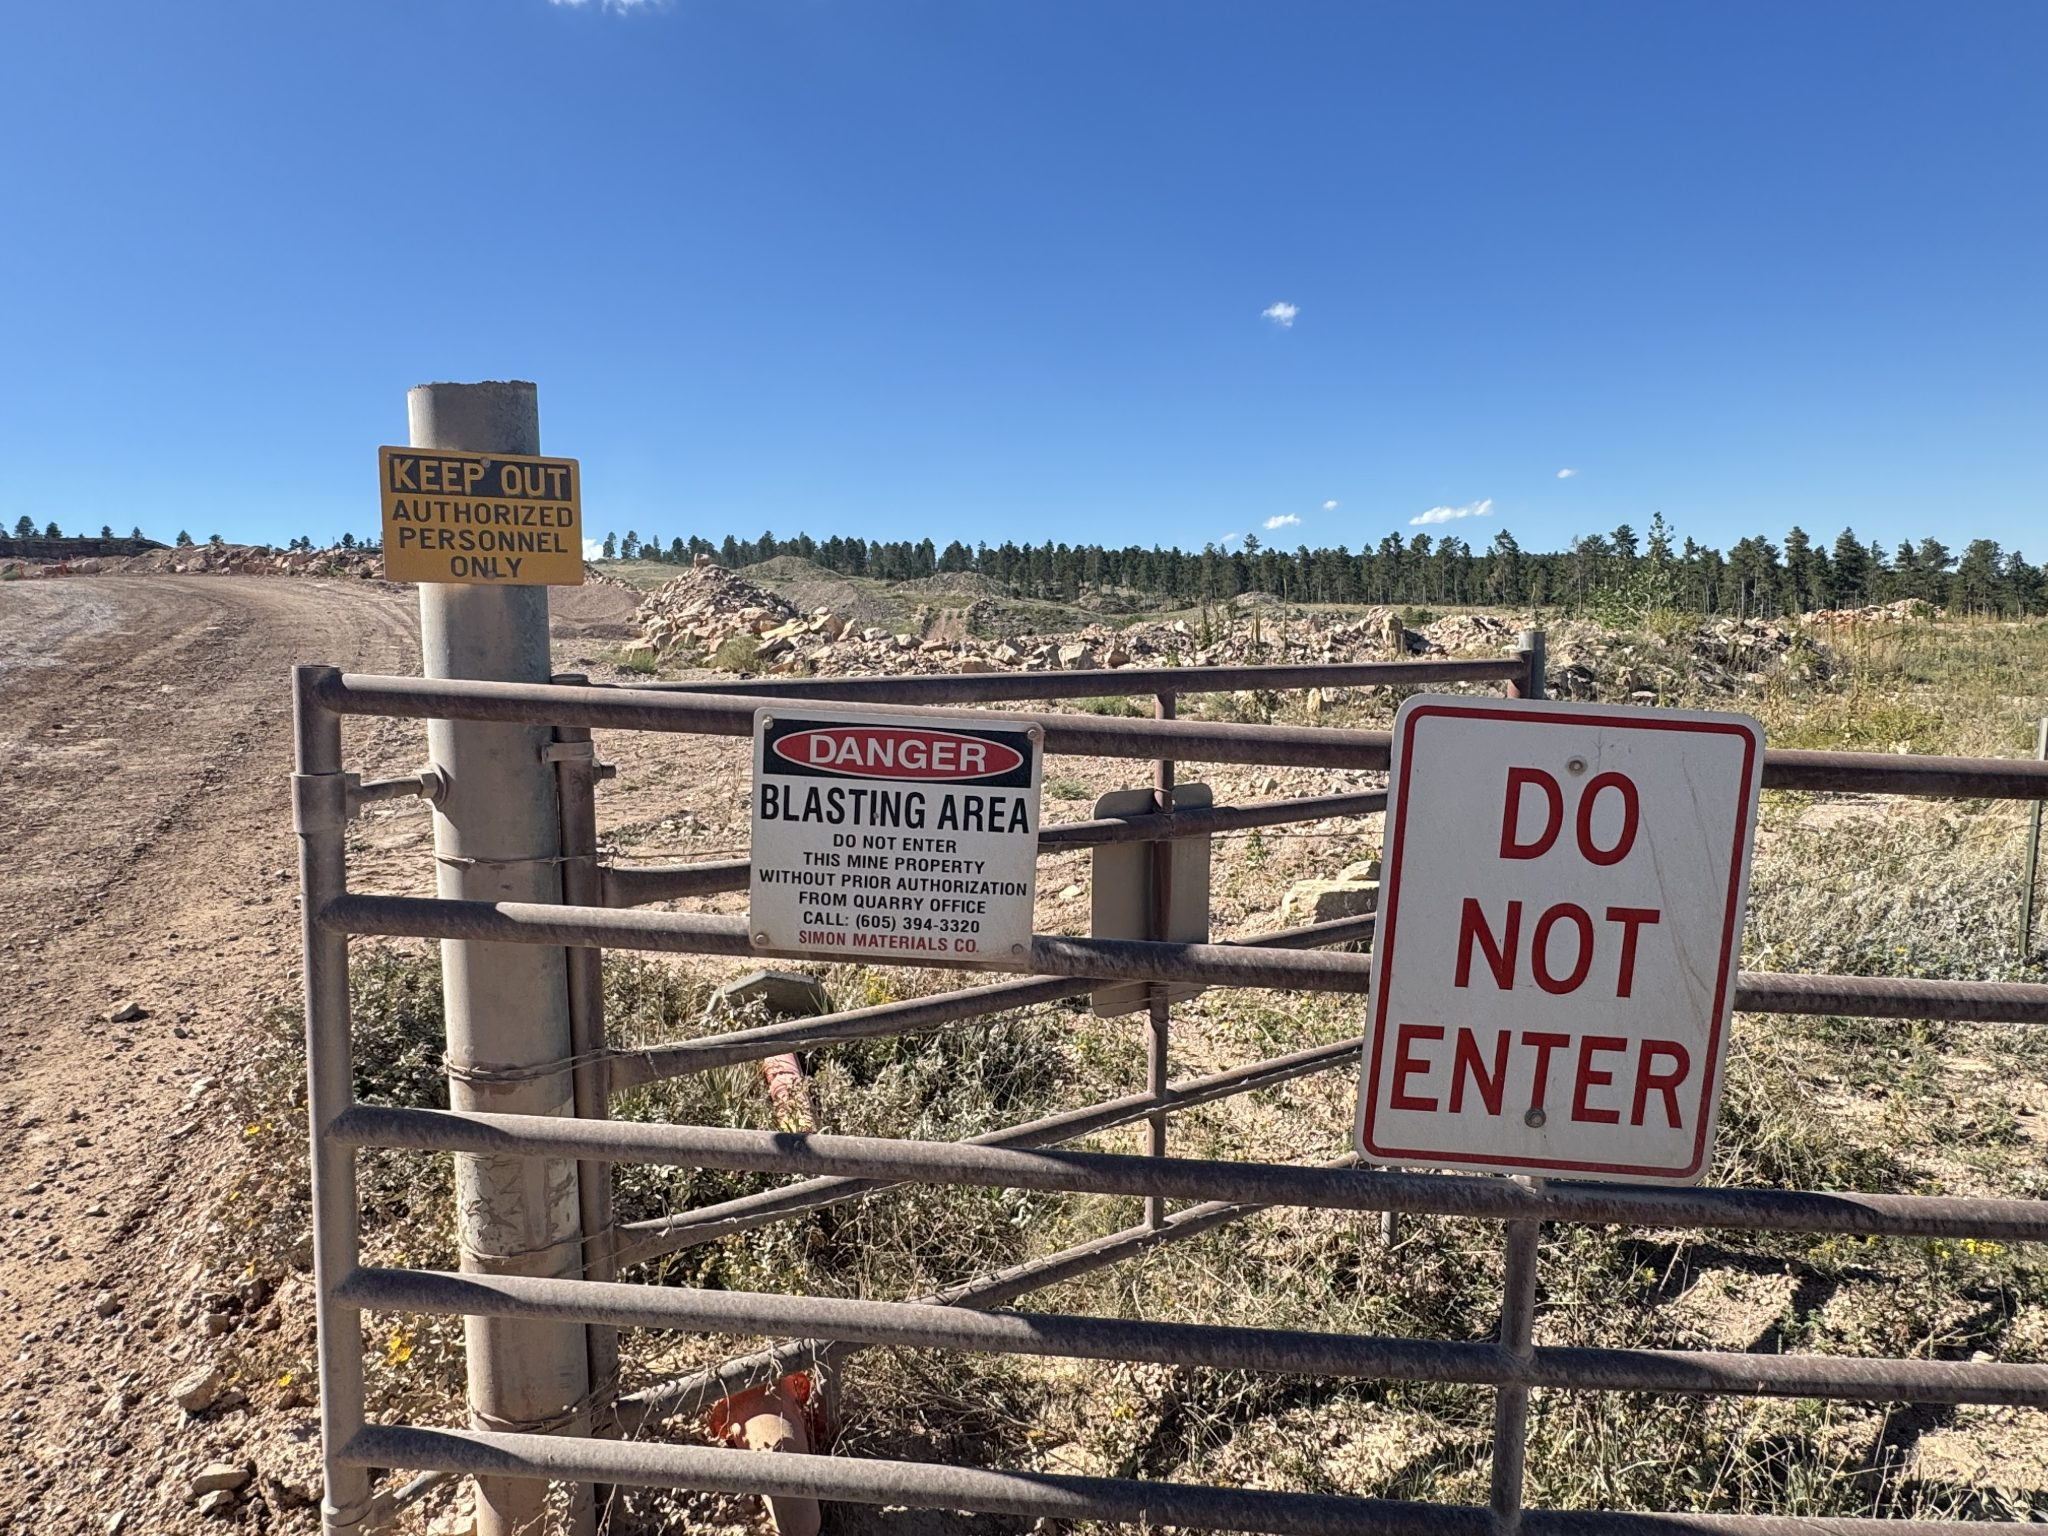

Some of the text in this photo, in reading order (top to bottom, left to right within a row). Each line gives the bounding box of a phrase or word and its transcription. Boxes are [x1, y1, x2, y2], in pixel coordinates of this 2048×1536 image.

[393, 458, 567, 498] KEEP OUT
[392, 500, 573, 527] AUTHORIZED
[399, 527, 568, 553] PERSONNEL
[451, 556, 523, 578] ONLY
[809, 734, 987, 773] DANGER
[761, 783, 1030, 834] BLASTING AREA
[1500, 767, 1639, 866] DO
[833, 834, 957, 853] DO NOT ENTER
[803, 852, 985, 874] THIS MINE PROPERTY
[759, 869, 1027, 896] WITHOUT PRIOR AUTHORIZATION
[799, 892, 986, 914] FROM QUARRY OFFICE
[803, 911, 980, 933] CALL: (605) 394-3320
[799, 930, 979, 953] SIMON MATERIALS CO.
[1454, 898, 1661, 998] NOT
[1390, 1024, 1691, 1129] ENTER
